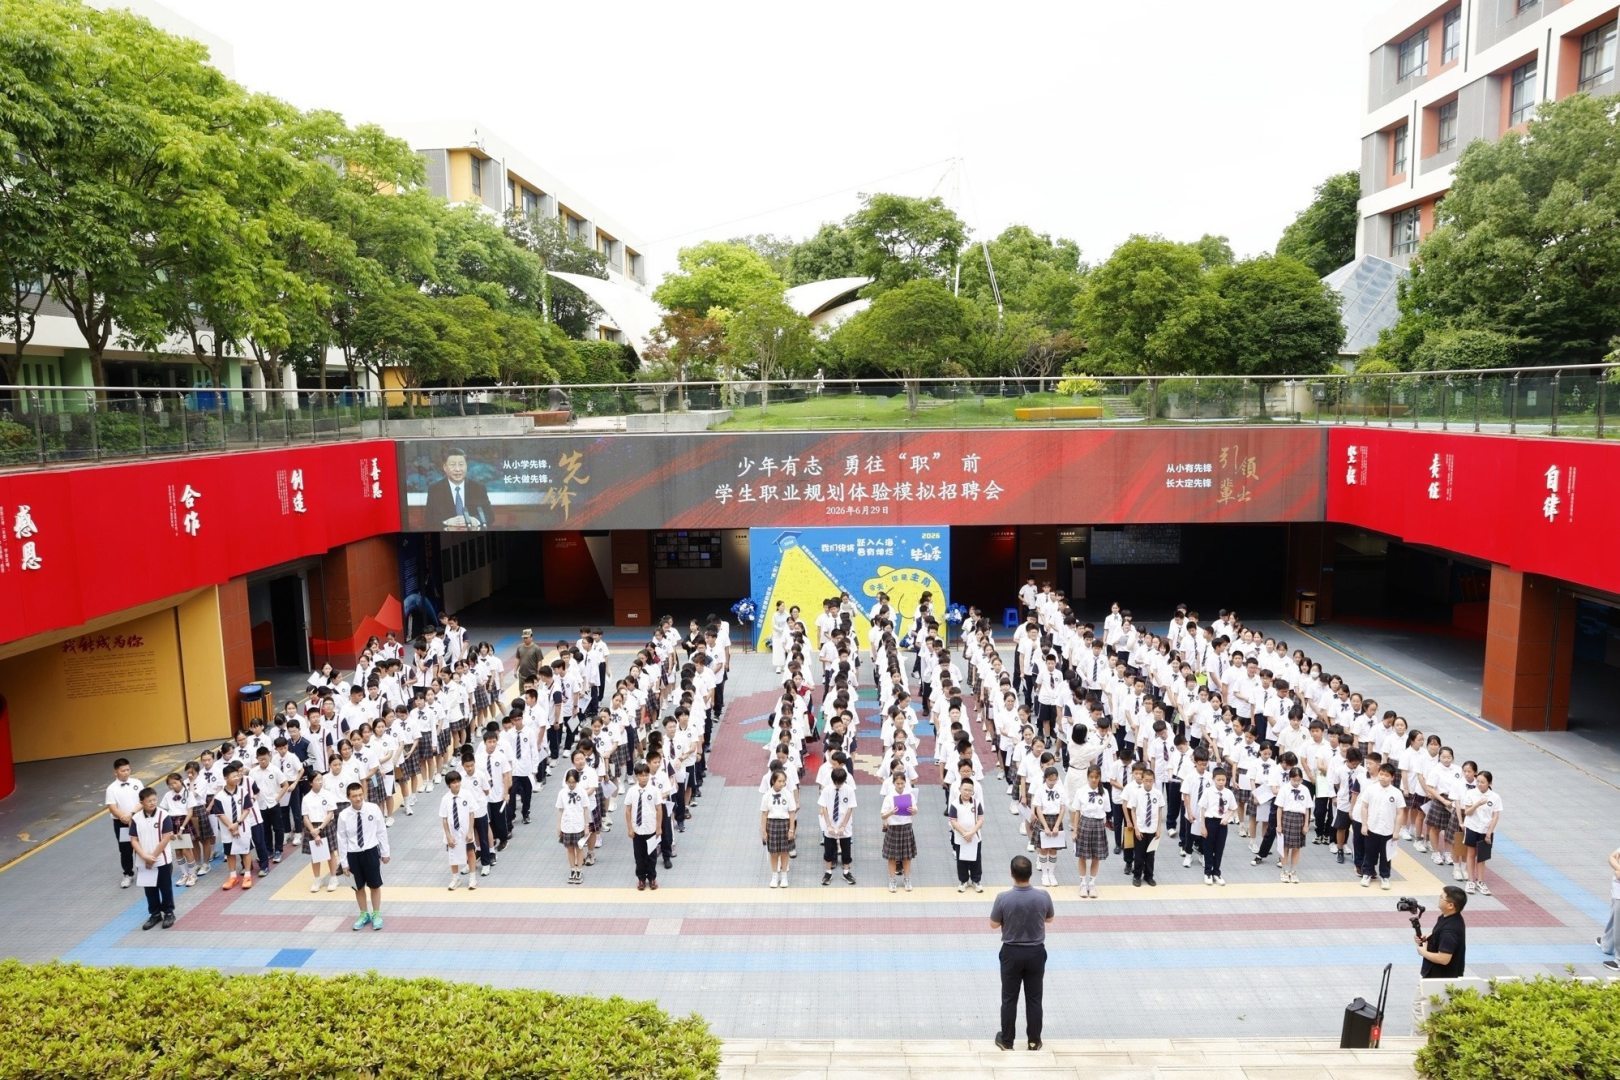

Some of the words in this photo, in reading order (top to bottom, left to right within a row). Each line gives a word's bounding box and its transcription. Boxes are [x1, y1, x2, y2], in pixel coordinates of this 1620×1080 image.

[737, 455, 823, 478] 少年有志
[1166, 463, 1213, 473] 从小有先锋
[714, 480, 1005, 504] 学生职业规划体验模拟招聘会
[1165, 478, 1212, 488] 长大定先锋
[1542, 464, 1561, 523] 自律
[180, 484, 202, 537] 合作
[825, 506, 890, 516] 2026年6月29日
[13, 504, 43, 571] 感恩
[910, 545, 942, 562] 毕业季
